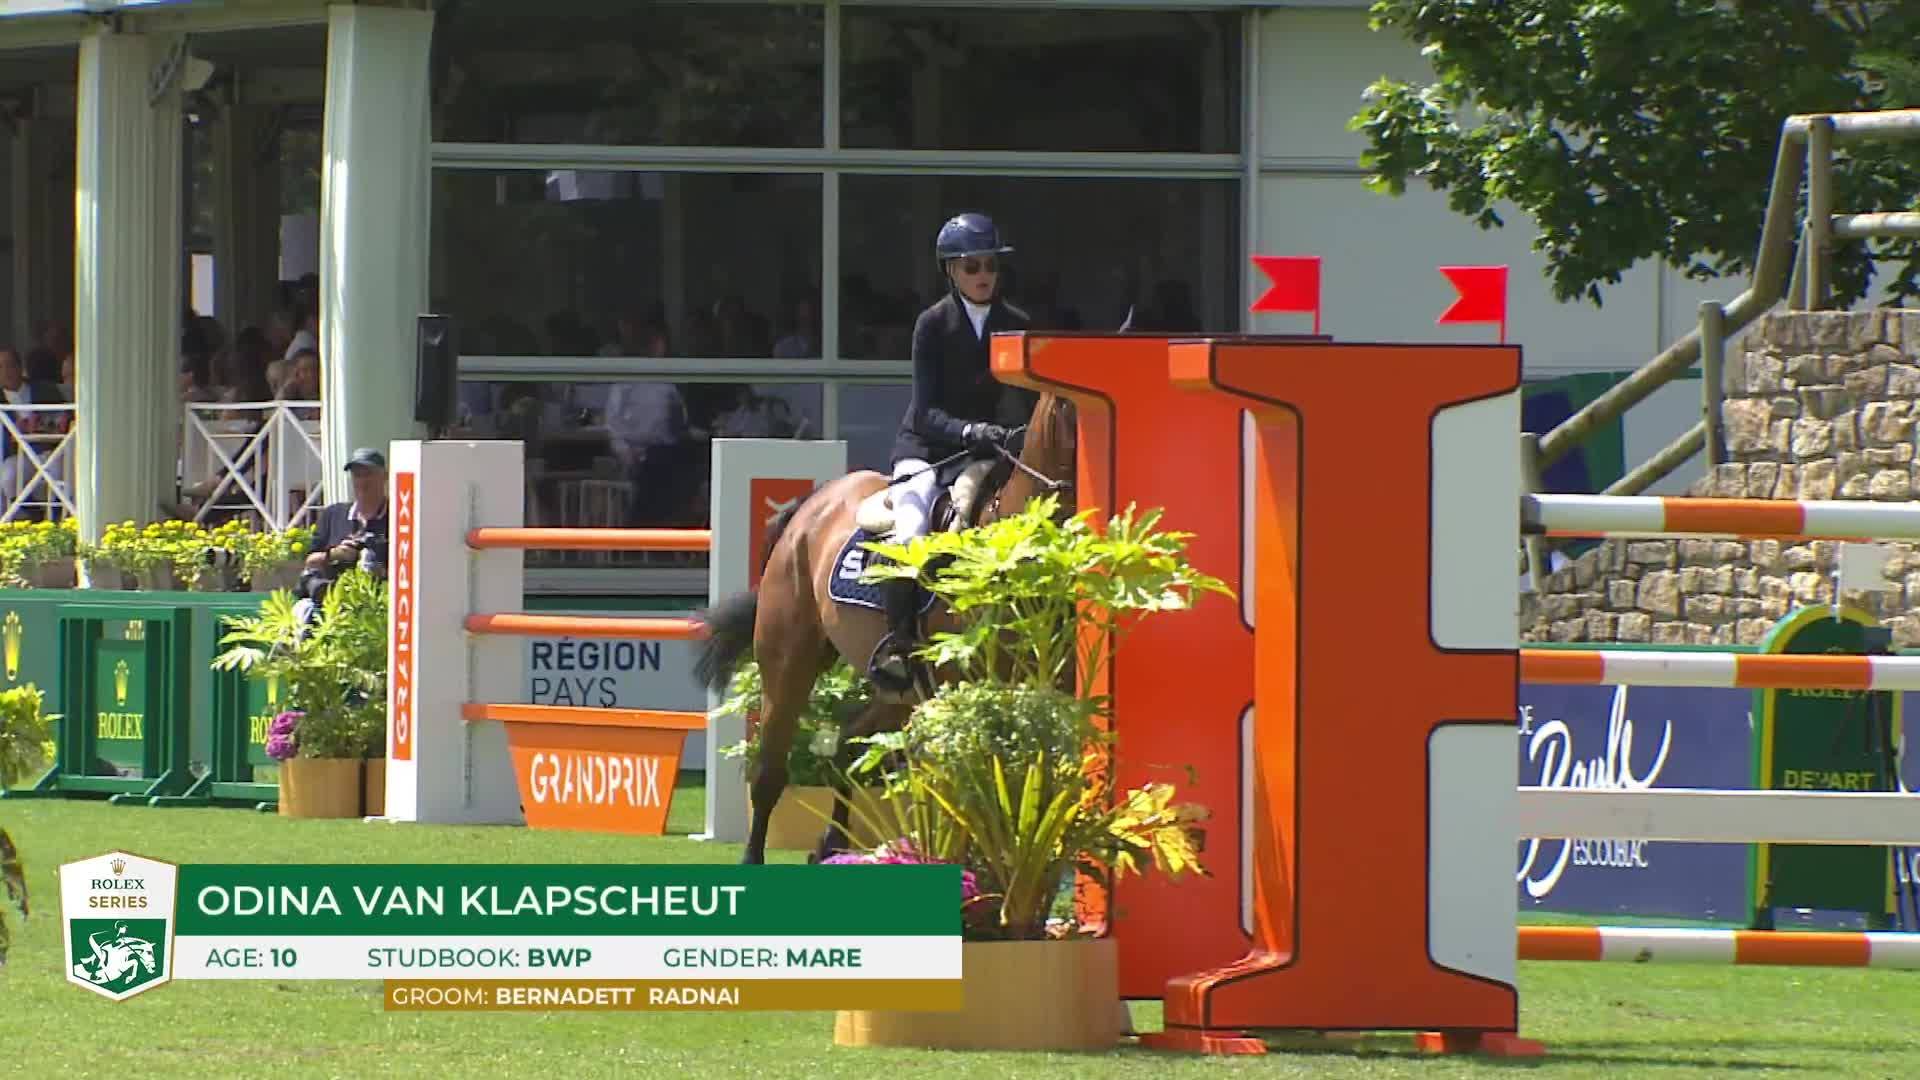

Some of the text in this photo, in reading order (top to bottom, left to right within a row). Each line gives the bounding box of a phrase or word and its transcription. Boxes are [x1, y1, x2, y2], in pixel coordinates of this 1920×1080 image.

[395, 488, 411, 745] GRANDPRIX
[531, 636, 662, 671] RÉGION
[531, 676, 617, 707] PAYS
[97, 712, 144, 740] ROLEX
[530, 752, 661, 808] GRANDPRIX
